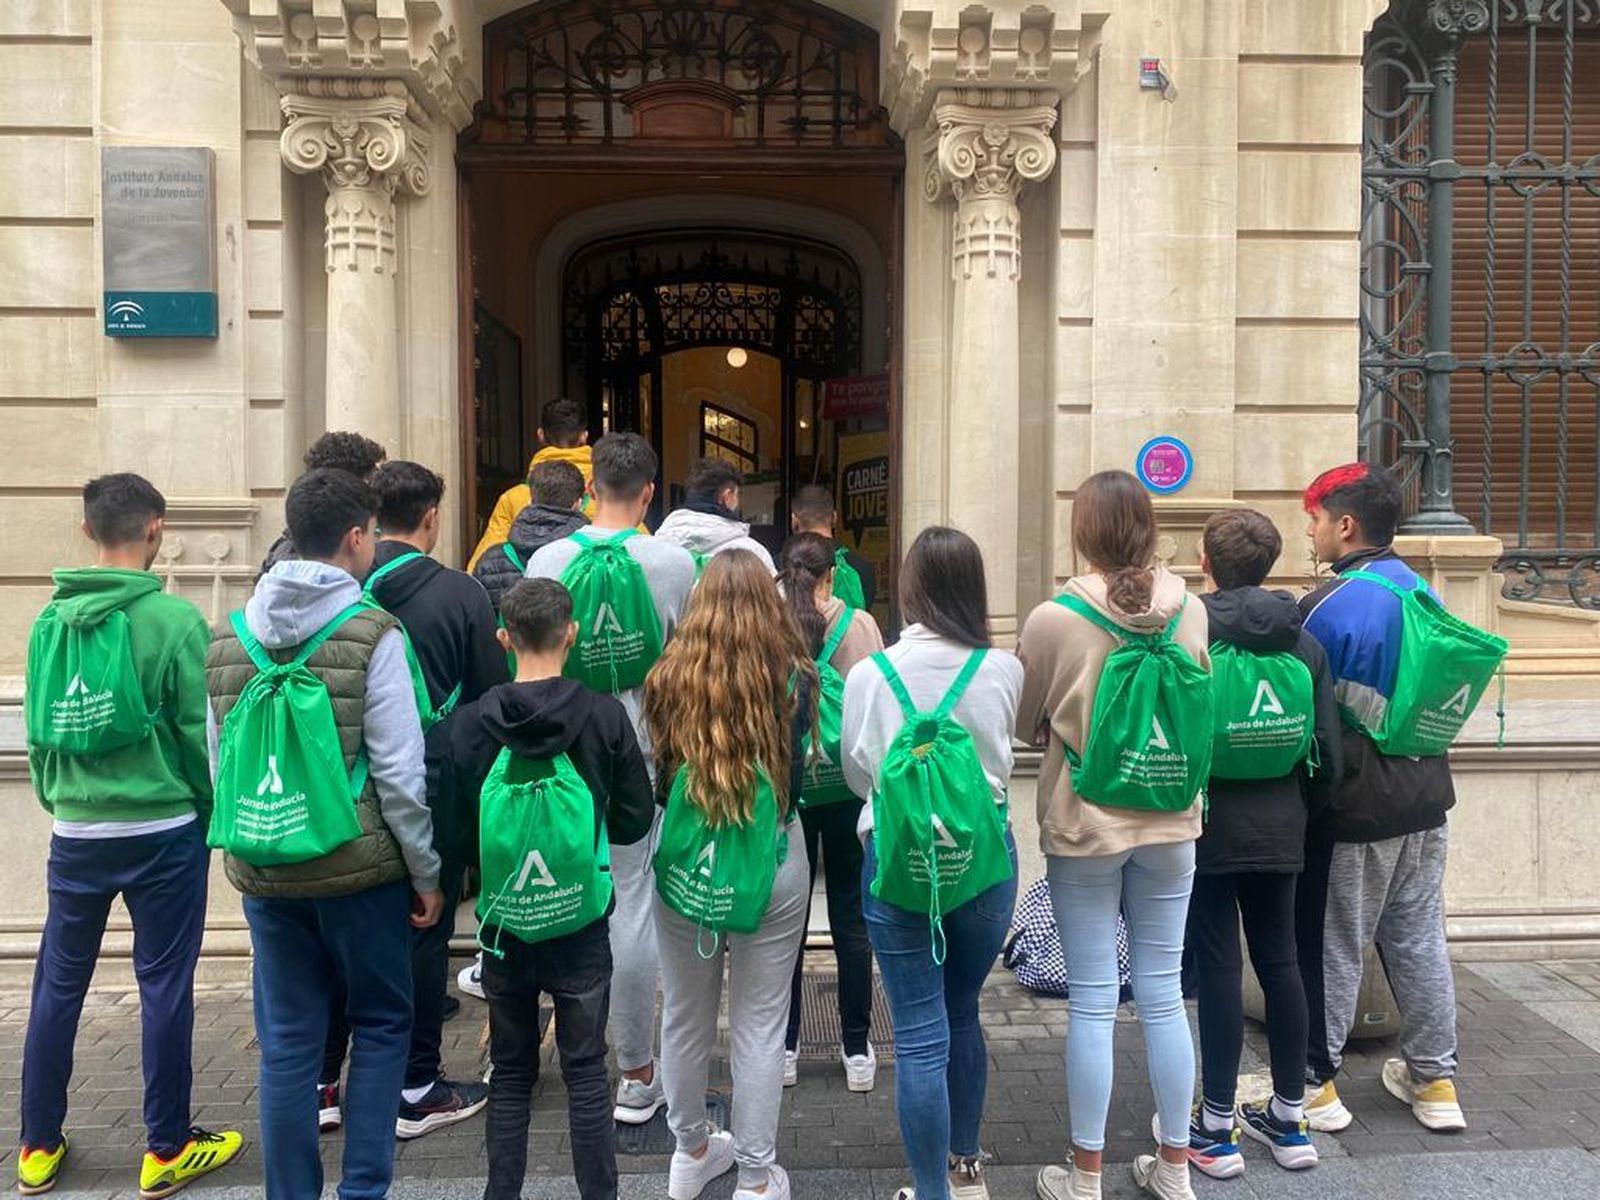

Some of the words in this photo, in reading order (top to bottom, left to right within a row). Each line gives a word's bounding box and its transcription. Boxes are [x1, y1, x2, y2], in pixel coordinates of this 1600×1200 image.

[104, 169, 154, 184] Instituto
[121, 186, 135, 198] de
[139, 186, 150, 198] la
[154, 186, 205, 198] Juventud
[849, 491, 887, 519] JOVE
[1252, 718, 1264, 727] de
[518, 896, 533, 905] de
[533, 882, 584, 902] Andalucía
